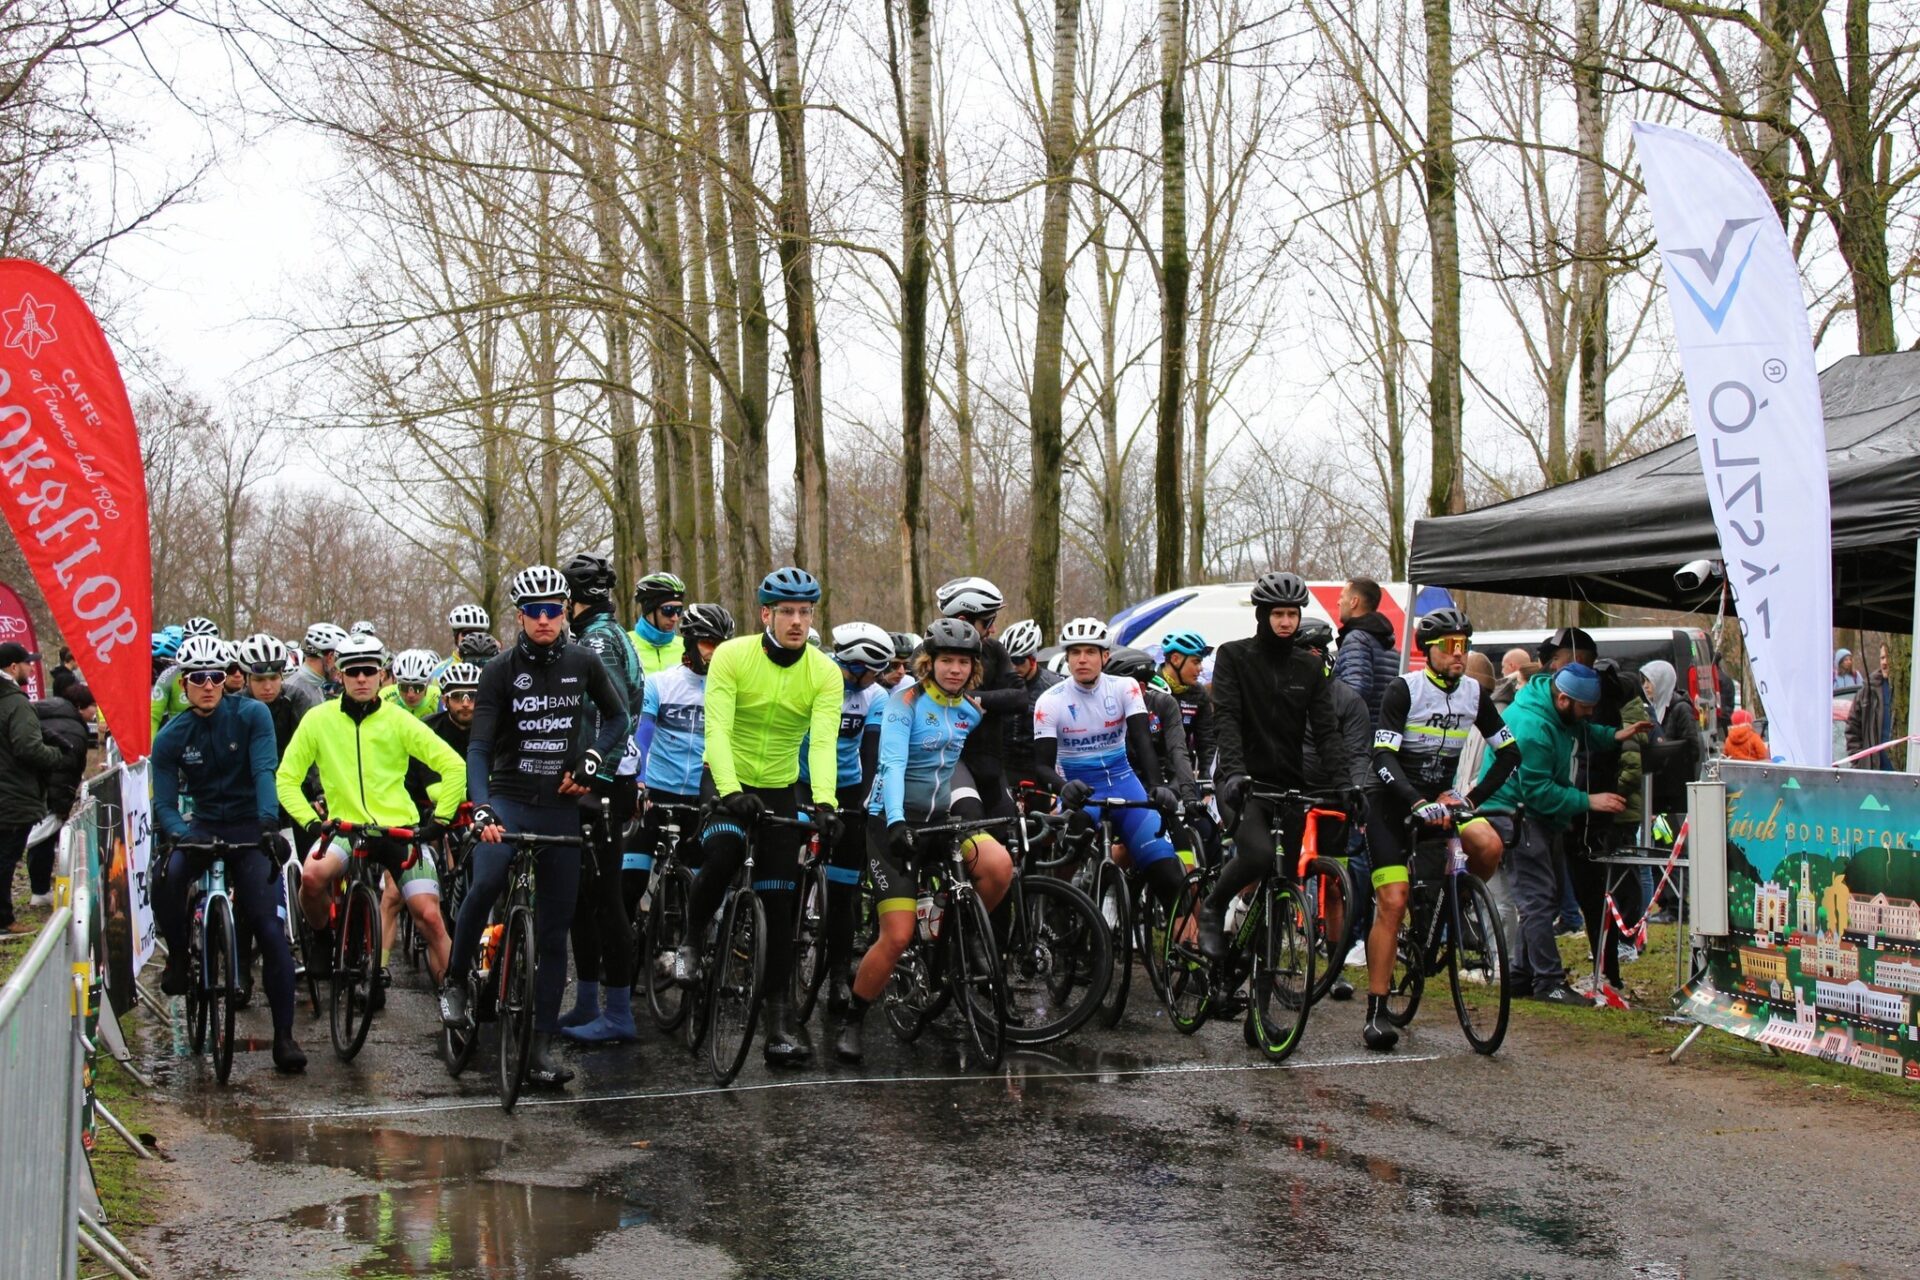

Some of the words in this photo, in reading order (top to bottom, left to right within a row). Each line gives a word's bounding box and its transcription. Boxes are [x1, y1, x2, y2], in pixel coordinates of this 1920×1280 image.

[29, 368, 42, 382] a
[33, 383, 78, 450] Firenze
[75, 452, 104, 483] dal
[91, 484, 120, 520] 1950
[0, 367, 138, 664] OKAFLOR
[549, 695, 581, 708] BANK
[665, 708, 705, 721] ELTE
[1425, 712, 1465, 730] RCT
[518, 716, 573, 733] COLPACK
[1377, 767, 1395, 784] RCT
[1787, 822, 1907, 850] BORBIRTOK
